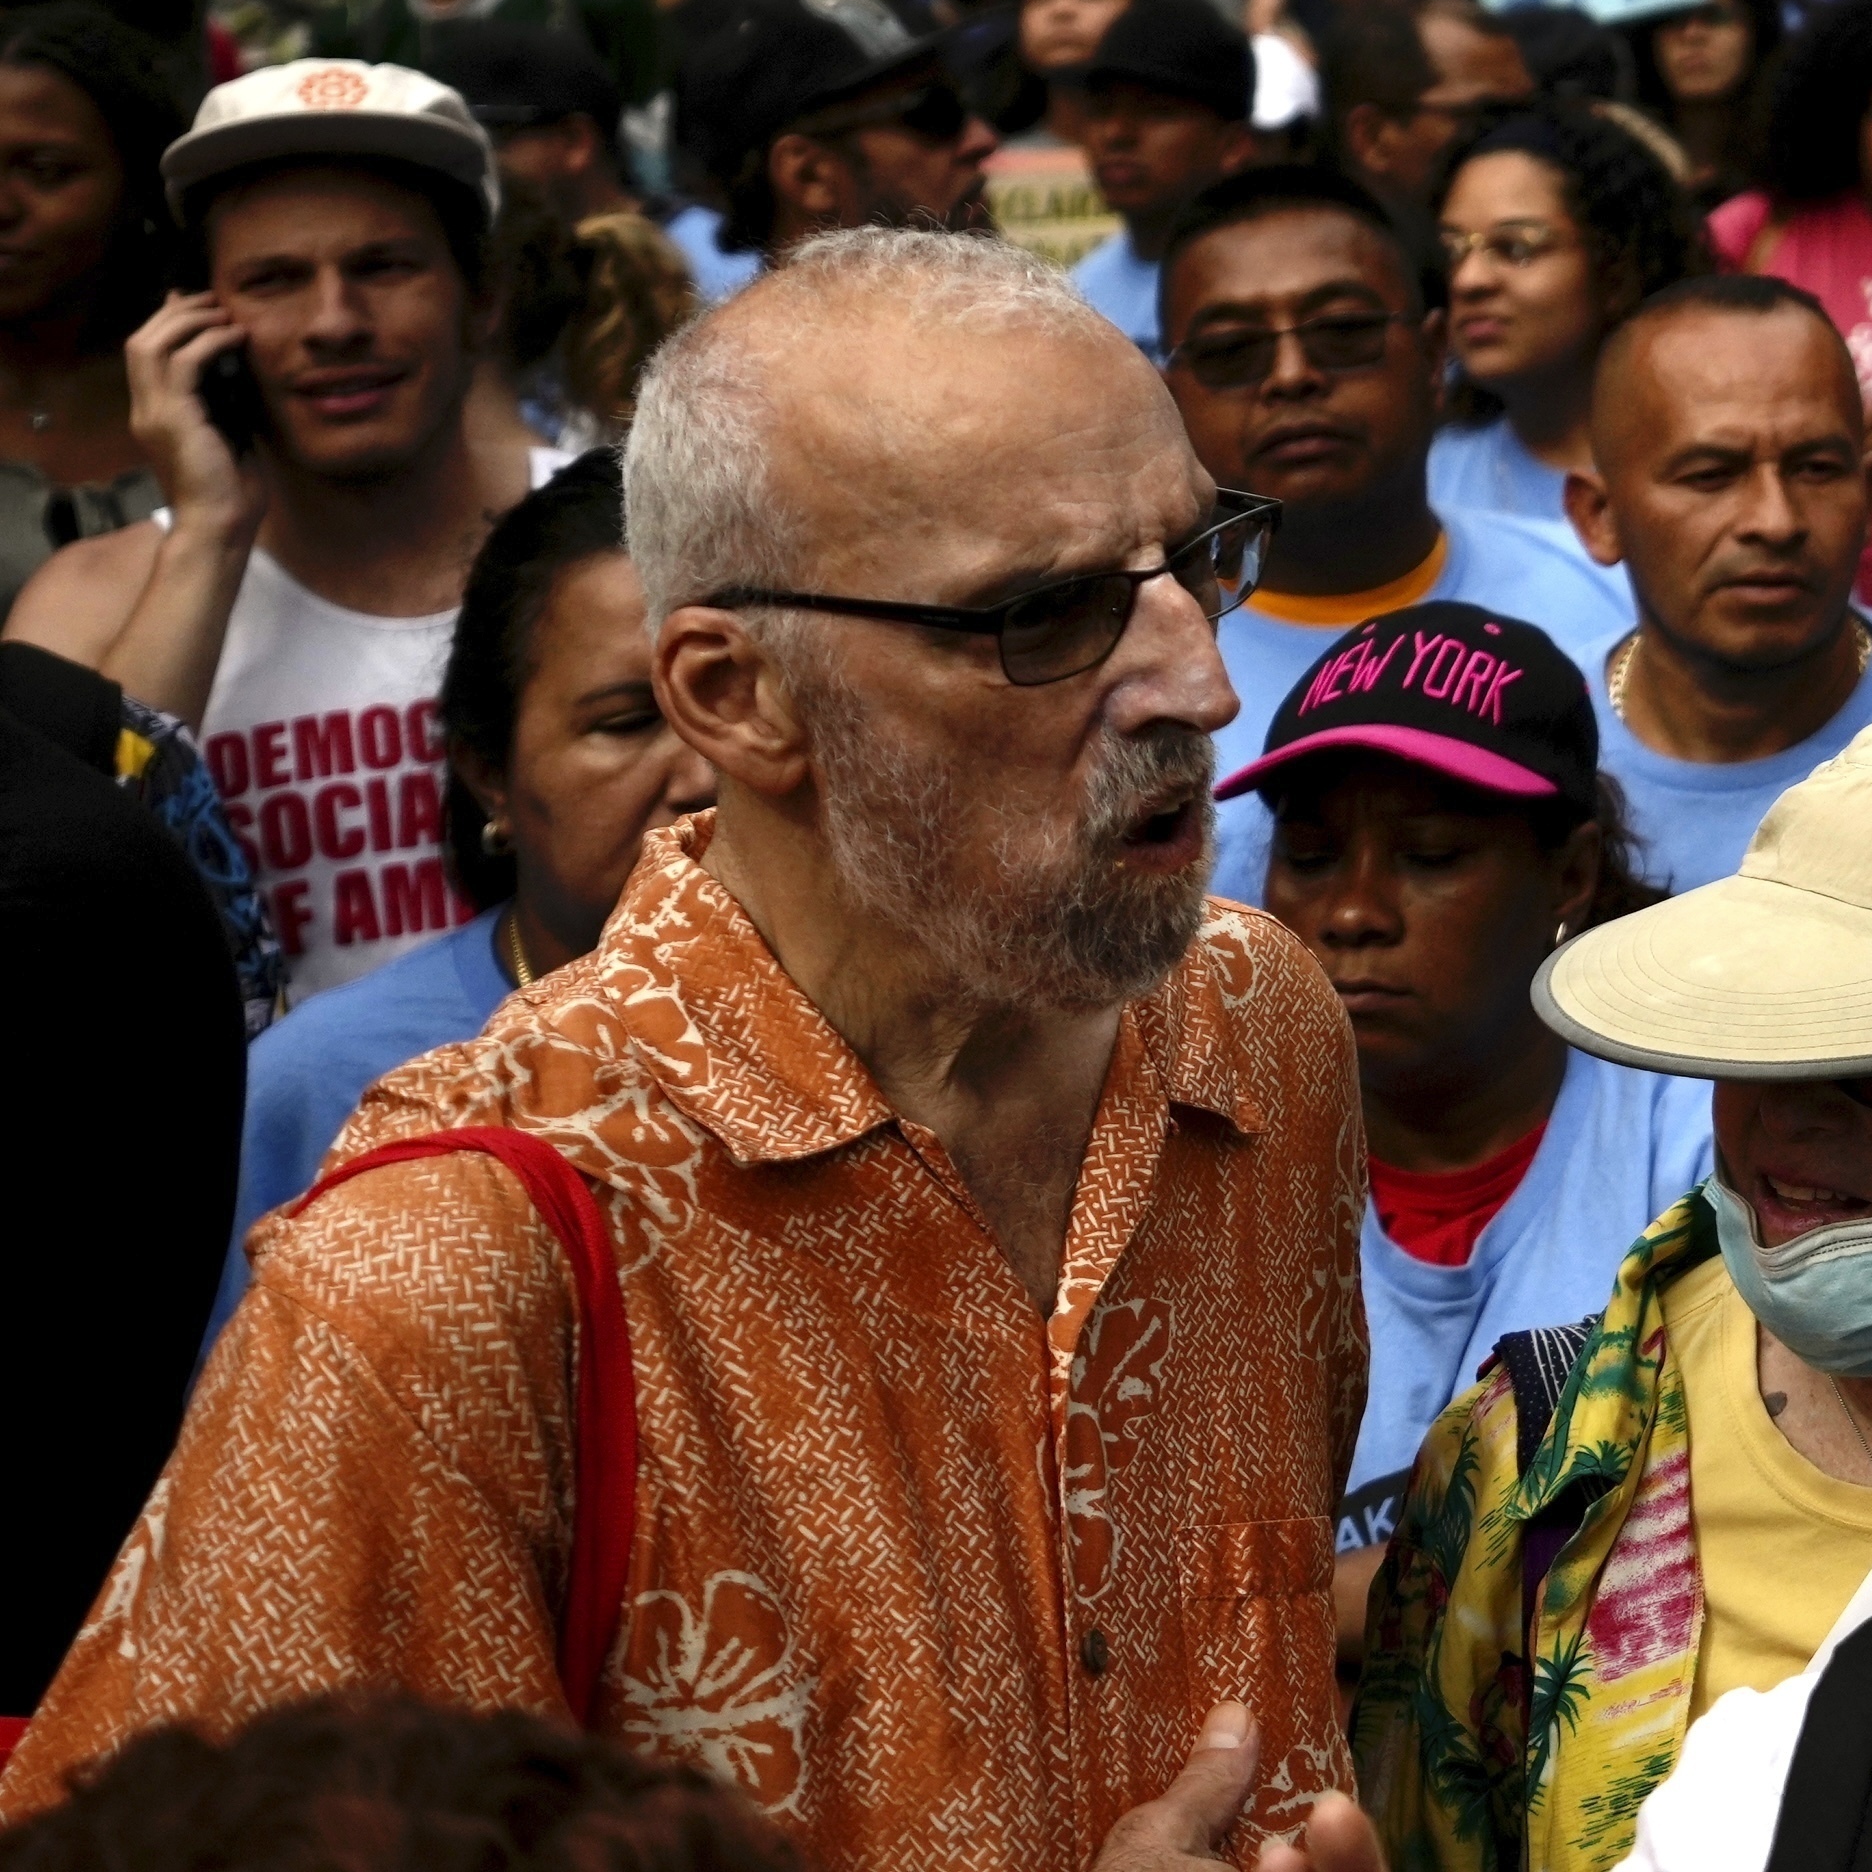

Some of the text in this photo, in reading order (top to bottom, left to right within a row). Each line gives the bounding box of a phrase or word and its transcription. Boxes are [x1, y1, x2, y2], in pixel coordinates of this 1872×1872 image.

[1298, 630, 1524, 726] NEW YORK
[273, 857, 476, 957] F AM
